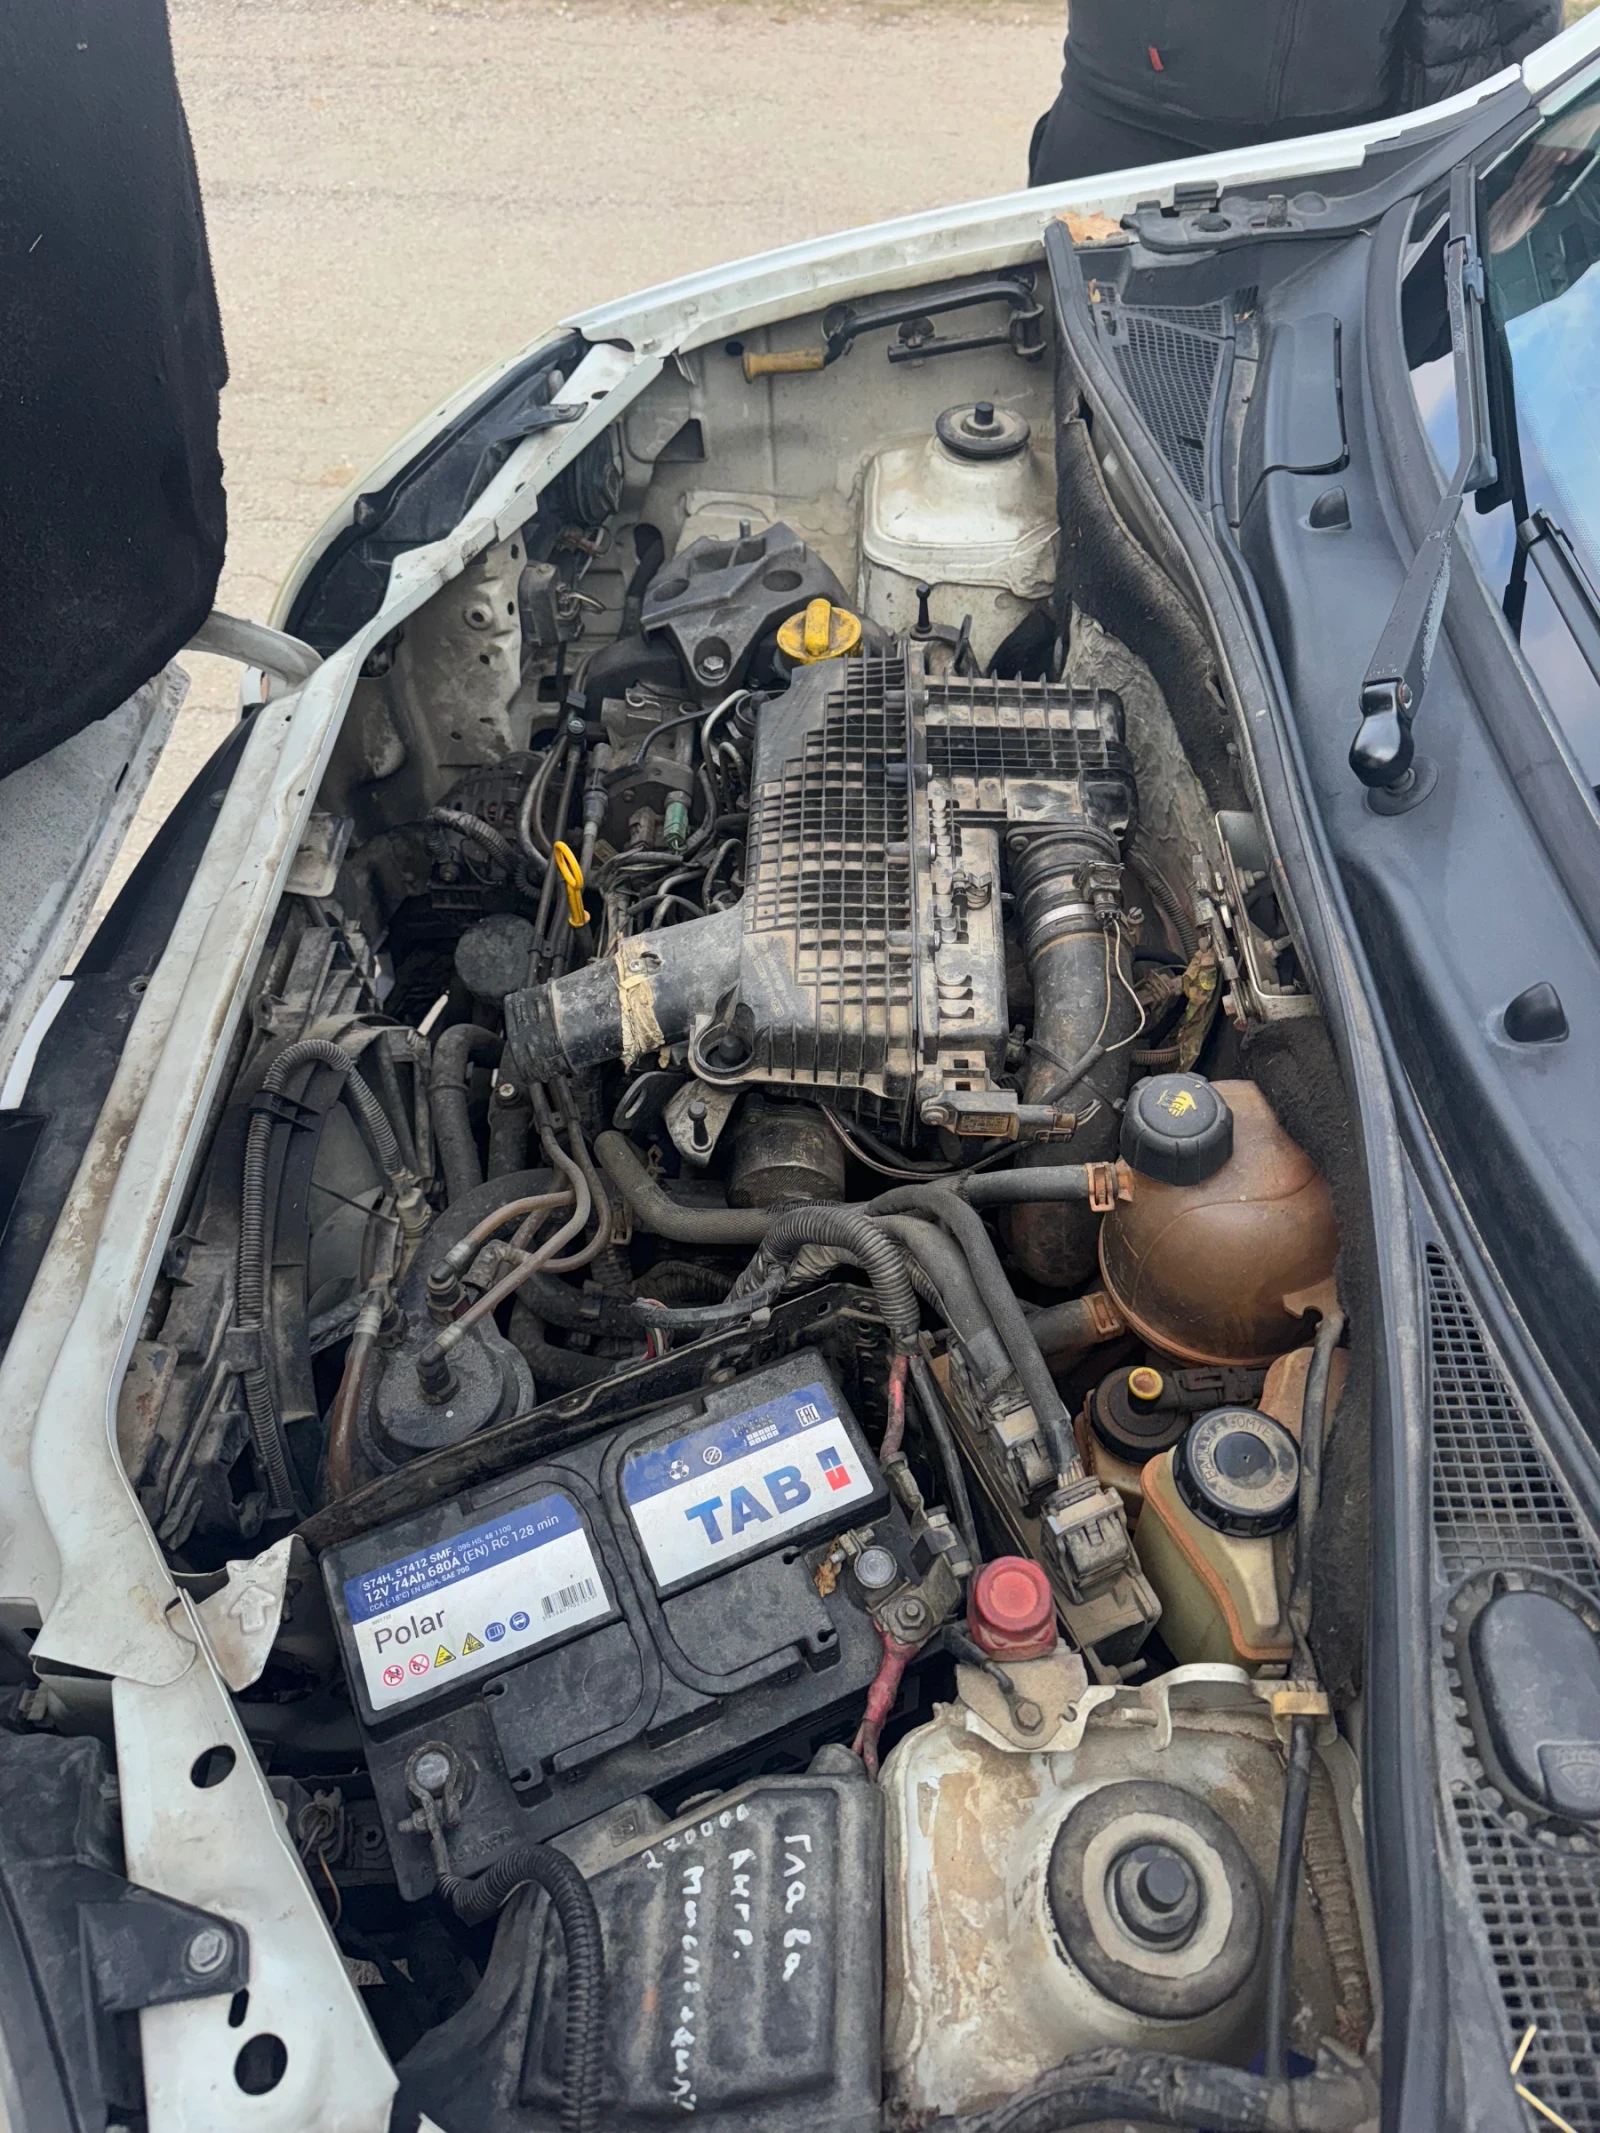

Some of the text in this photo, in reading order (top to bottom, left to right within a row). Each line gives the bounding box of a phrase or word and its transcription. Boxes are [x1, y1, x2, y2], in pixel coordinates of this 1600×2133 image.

[684, 1465, 811, 1545] TAB
[362, 1572, 394, 1592] S74H,
[395, 1557, 429, 1578] 57412
[429, 1547, 456, 1564] SMF,
[365, 1515, 560, 1603] 12V 74Ah 680A (EN) RC 128 min
[369, 1600, 385, 1612] CCA
[410, 1586, 421, 1595] EN
[441, 1572, 456, 1582] SAE
[457, 1565, 470, 1575] 700
[373, 1609, 445, 1653] Polar
